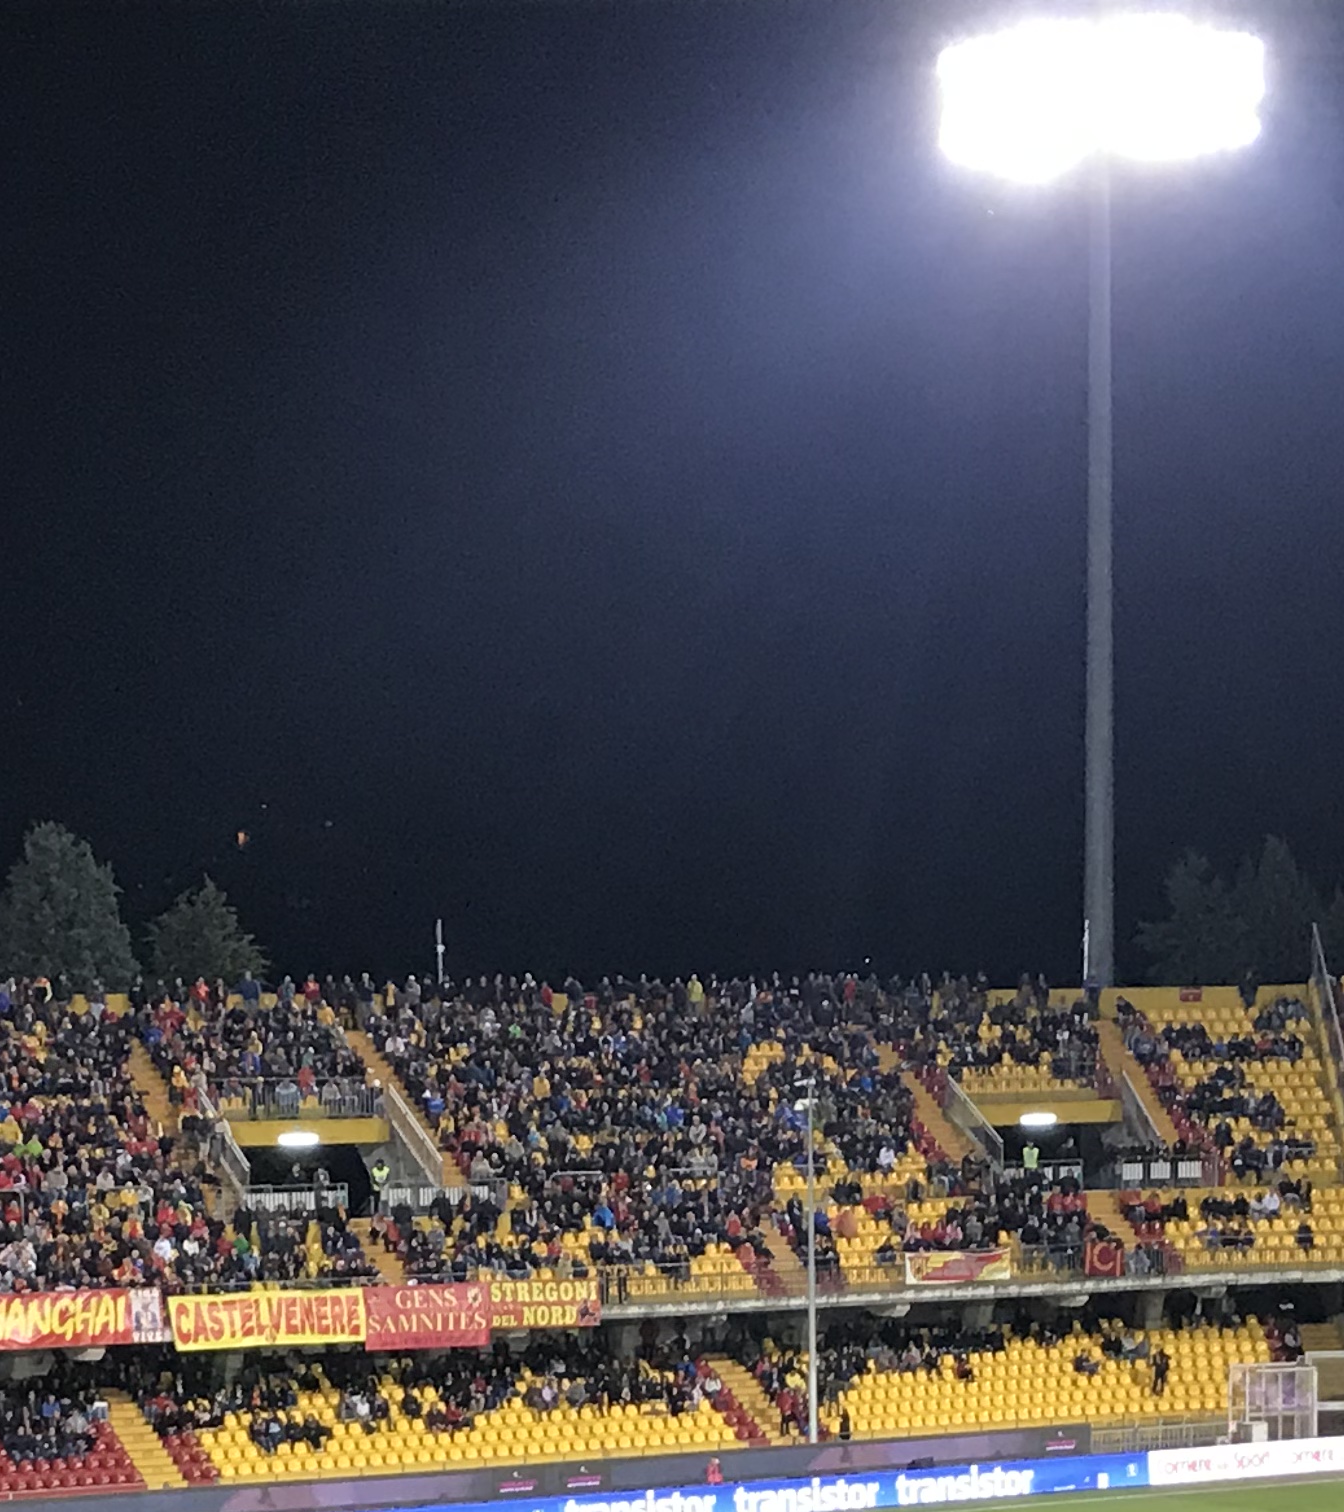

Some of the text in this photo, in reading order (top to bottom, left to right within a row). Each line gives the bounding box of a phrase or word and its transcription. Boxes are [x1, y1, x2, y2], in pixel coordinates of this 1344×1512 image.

[395, 1288, 457, 1309] GENS
[491, 1281, 597, 1302] STREGONI
[175, 1295, 361, 1345] CASTELVENERE
[368, 1310, 487, 1334] SAMNITES
[492, 1305, 578, 1327] DEL NORD
[1159, 1457, 1212, 1475] orriere
[895, 1464, 1035, 1505] transistor
